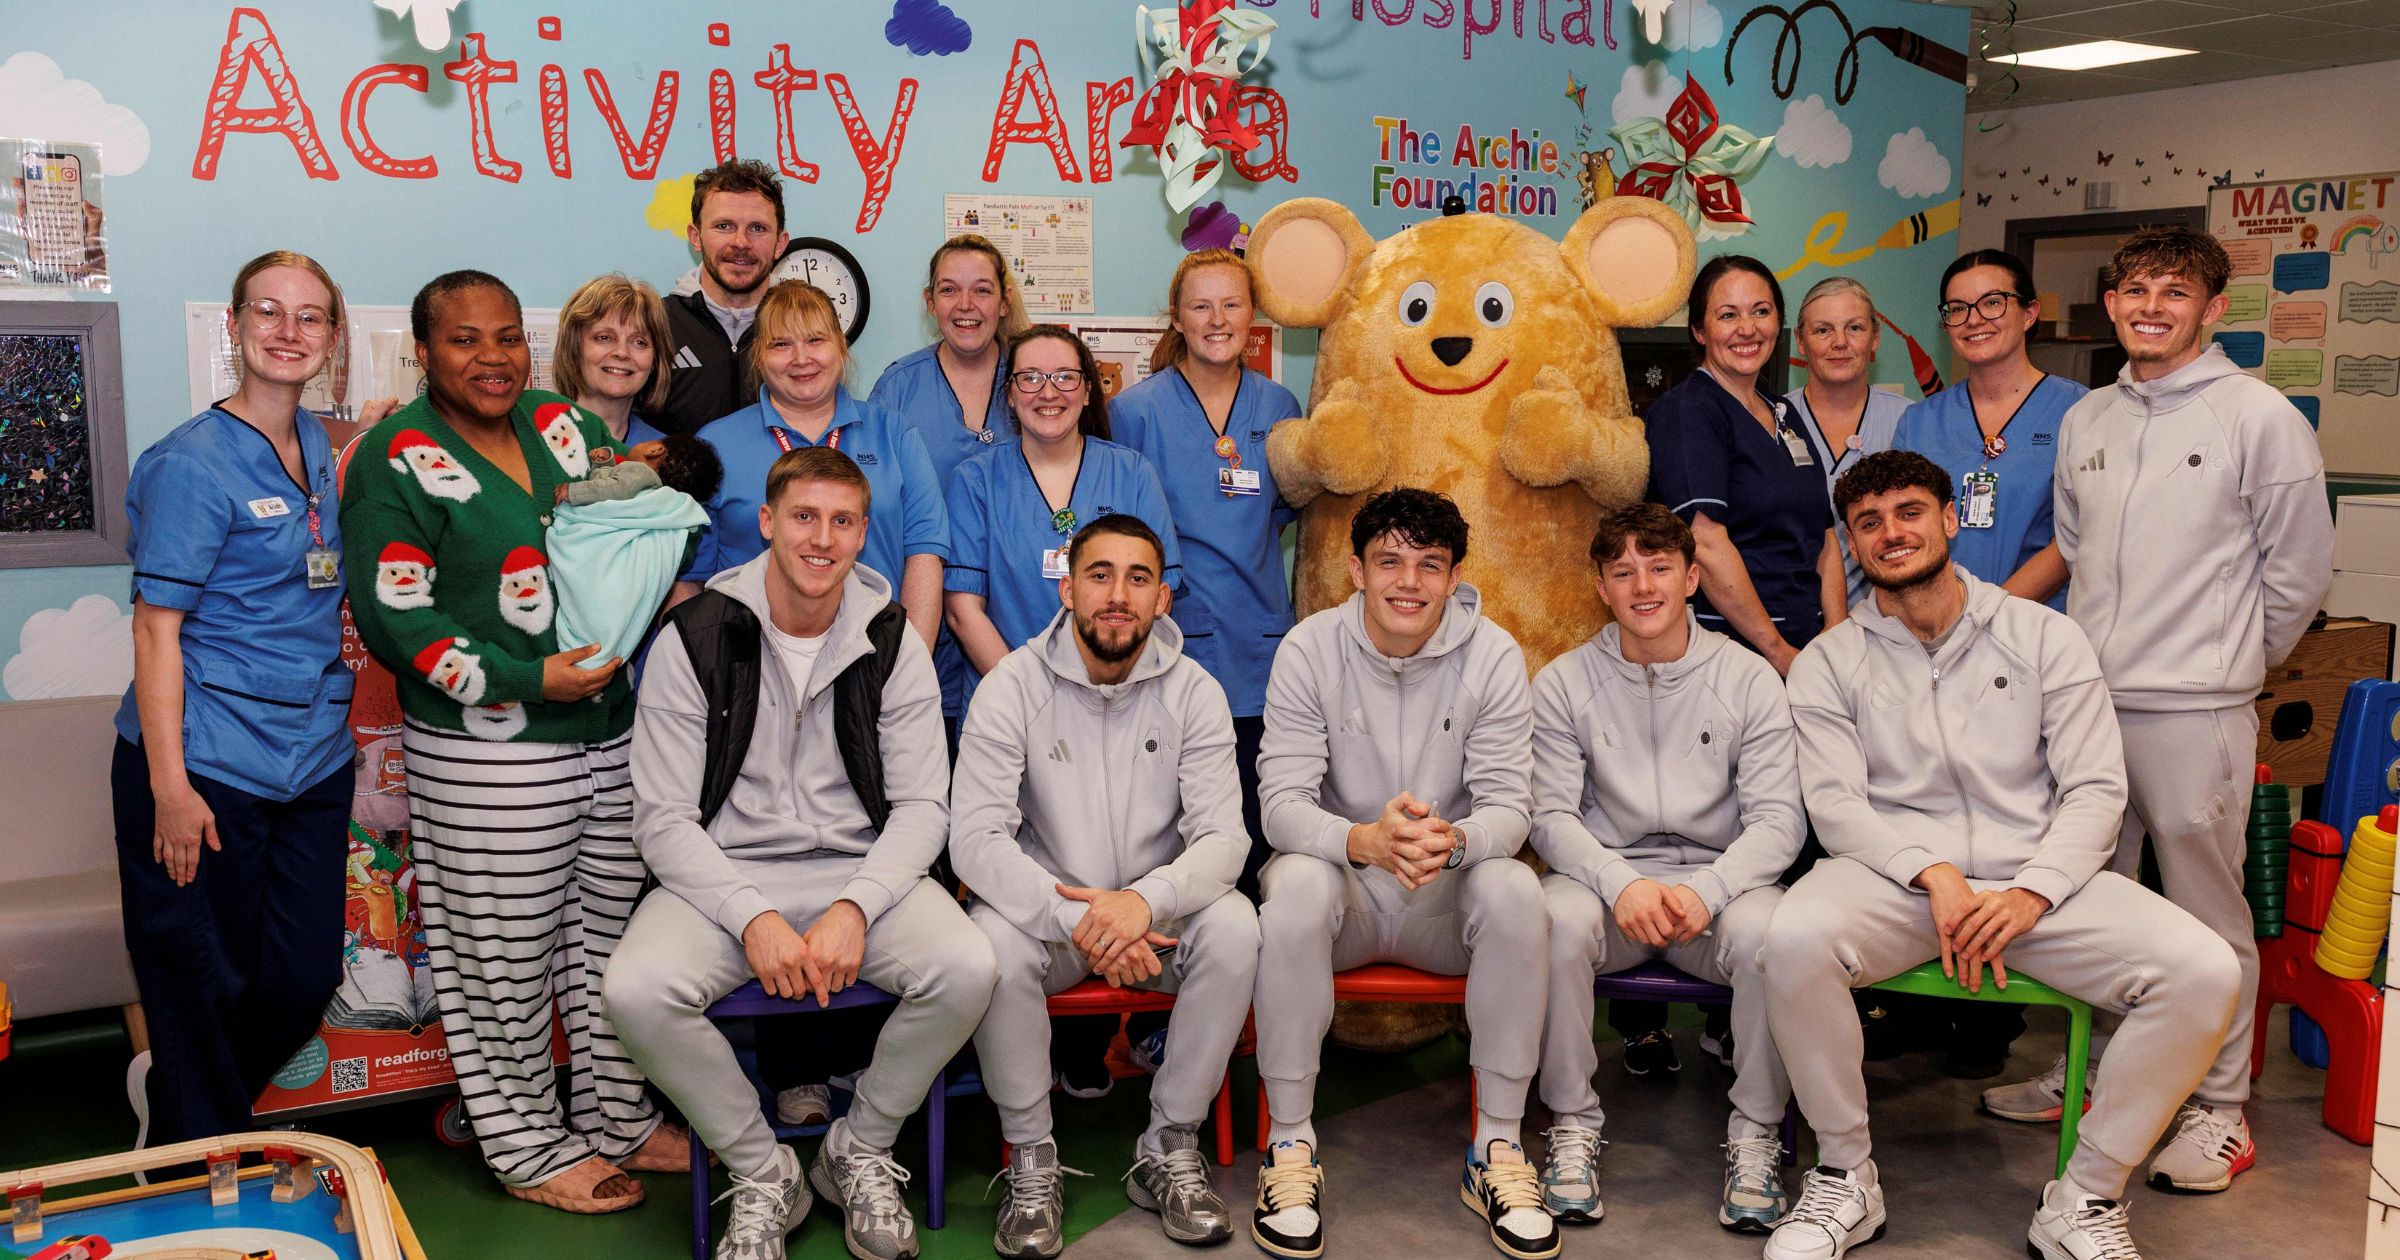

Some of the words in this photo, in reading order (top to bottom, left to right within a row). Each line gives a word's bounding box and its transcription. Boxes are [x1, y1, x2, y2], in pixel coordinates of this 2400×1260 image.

[192, 7, 919, 234] Activity
[982, 39, 1299, 184] Ara
[1373, 116, 1442, 166] The
[1452, 123, 1559, 174] Archie
[1372, 164, 1558, 217] Foundation
[2232, 177, 2395, 218] MAGNET
[2238, 219, 2265, 228] WHAT
[2266, 218, 2279, 226] WE
[2280, 217, 2307, 225] HAVE
[2246, 226, 2294, 236] ACHIEVED!
[30, 270, 64, 284] THANK
[839, 292, 847, 305] 3
[2033, 432, 2052, 440] NHS
[375, 1047, 449, 1068] readforg
